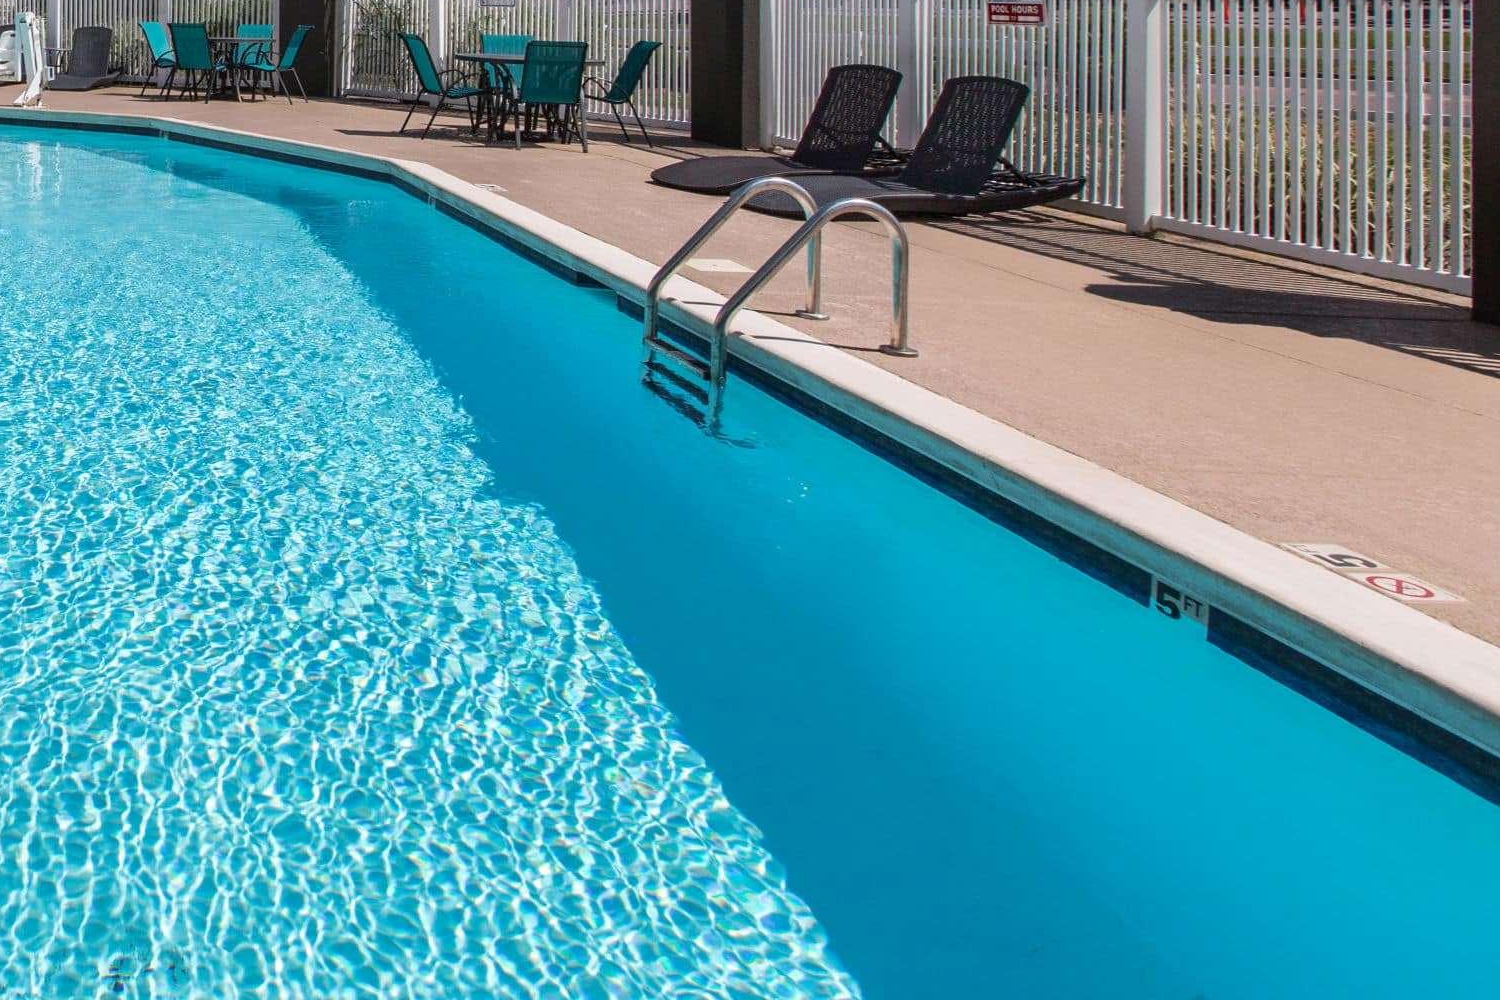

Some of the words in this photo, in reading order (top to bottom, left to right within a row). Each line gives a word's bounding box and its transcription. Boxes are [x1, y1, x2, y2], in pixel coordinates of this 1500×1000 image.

[991, 5, 1010, 14] POOL
[1012, 5, 1039, 14] HOURS
[1311, 554, 1378, 568] 5
[1156, 580, 1180, 619] 5
[1183, 594, 1203, 618] FT
